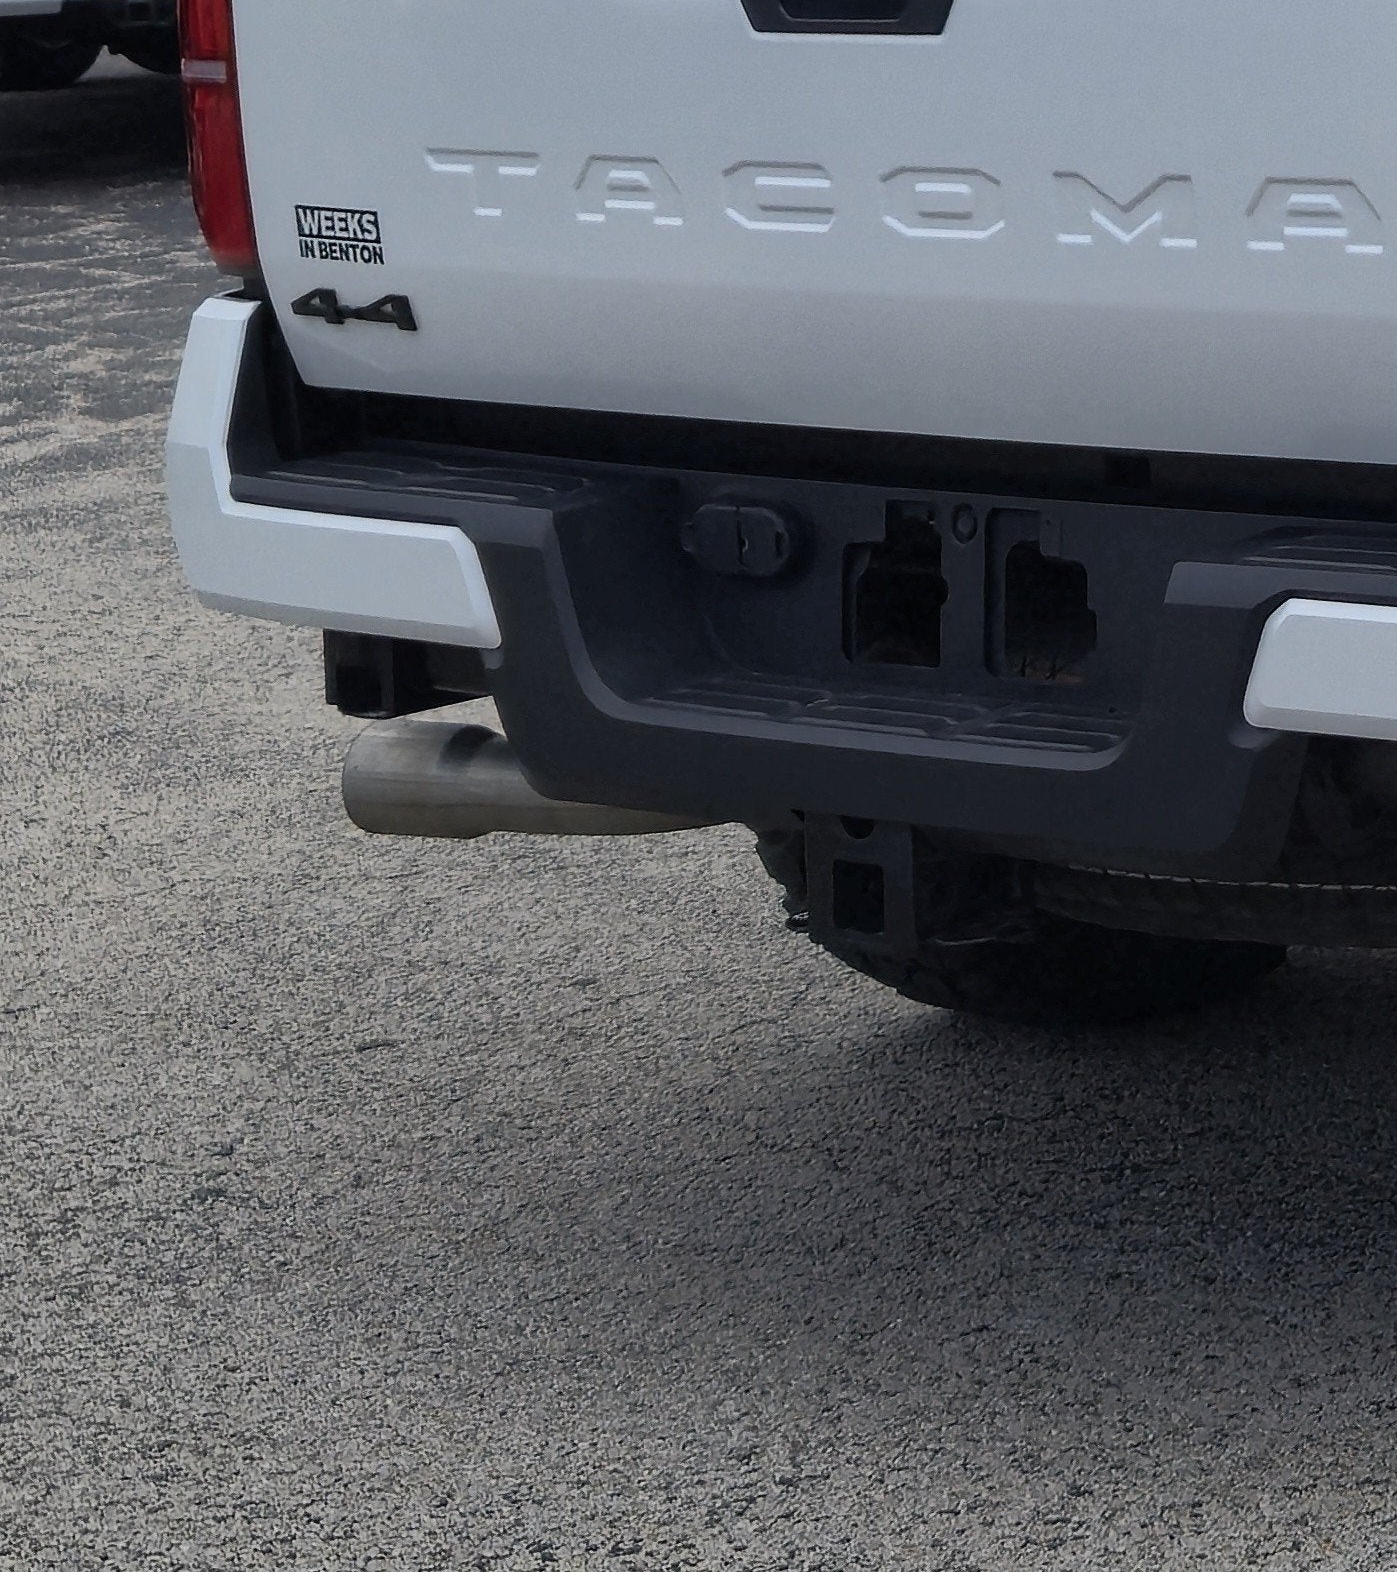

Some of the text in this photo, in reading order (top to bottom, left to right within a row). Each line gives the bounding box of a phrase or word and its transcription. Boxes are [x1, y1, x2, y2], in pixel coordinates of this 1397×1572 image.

[424, 146, 1385, 255] TACOMA
[298, 208, 379, 241] WEEKS
[299, 239, 385, 265] IN BENTON
